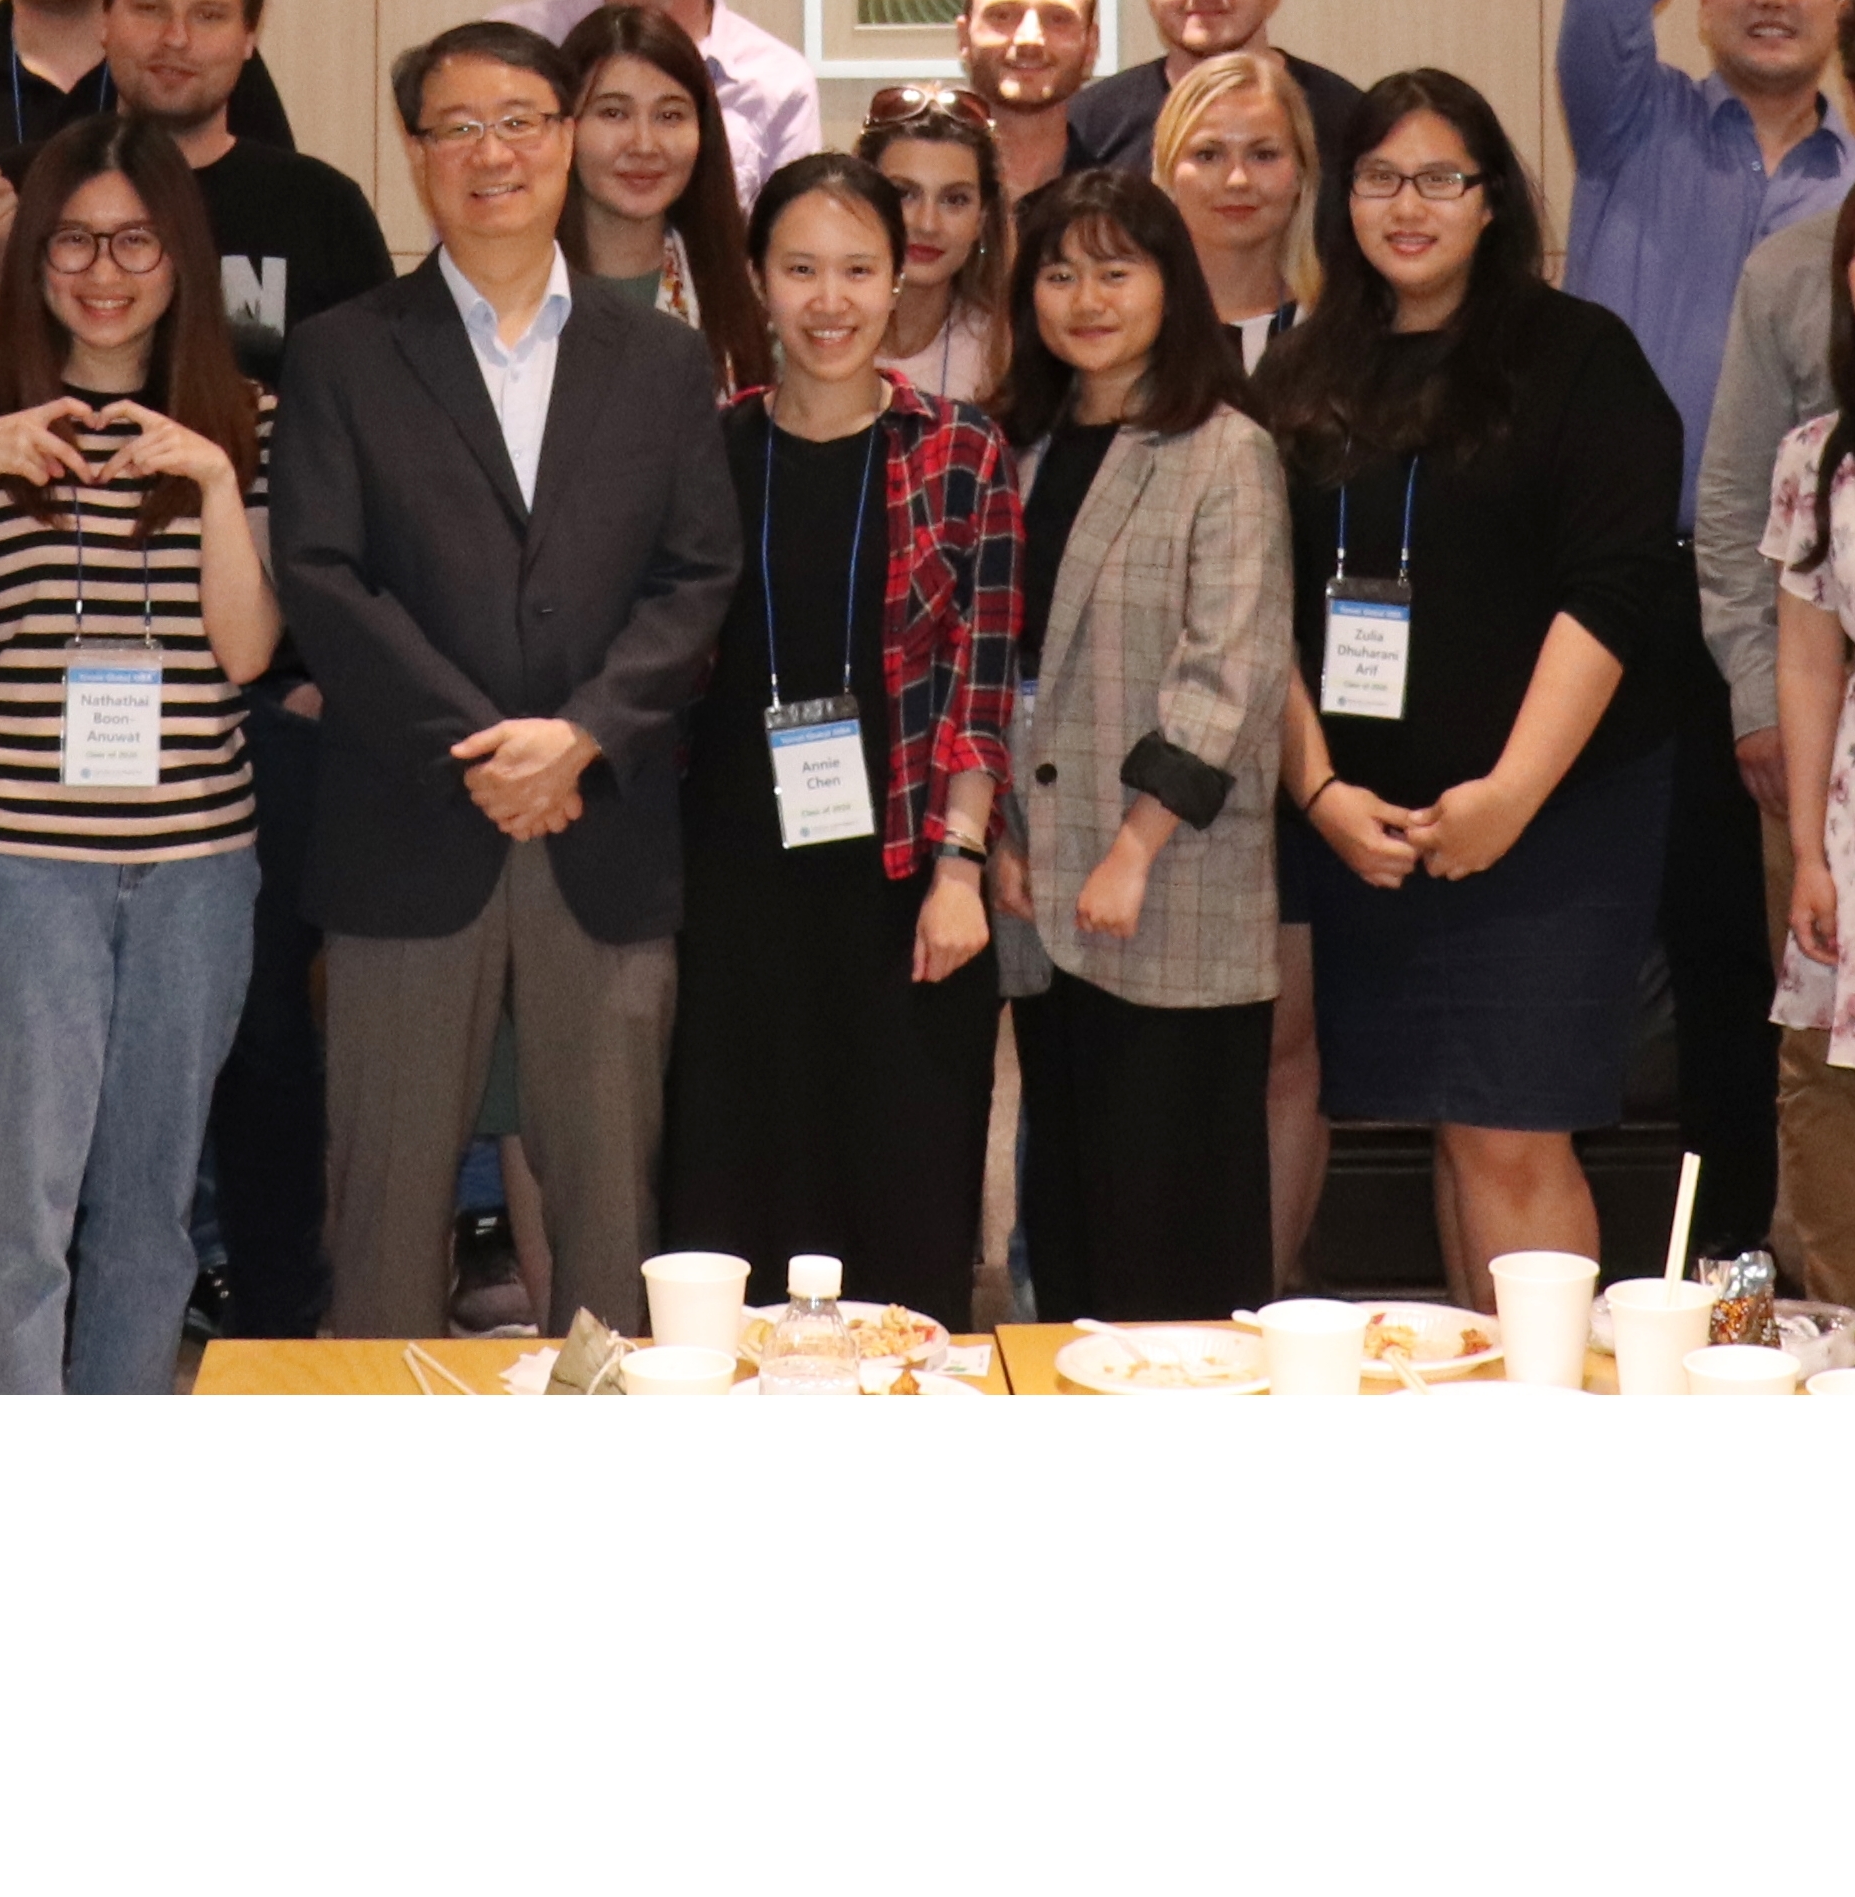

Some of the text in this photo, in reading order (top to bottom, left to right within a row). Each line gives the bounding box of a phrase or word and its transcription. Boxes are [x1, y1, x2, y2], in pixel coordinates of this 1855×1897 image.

[1354, 628, 1384, 642] Zulia
[1355, 664, 1378, 677] Arif
[86, 730, 141, 743] Anuwat
[802, 757, 841, 774] Annie
[806, 777, 842, 790] Chen
